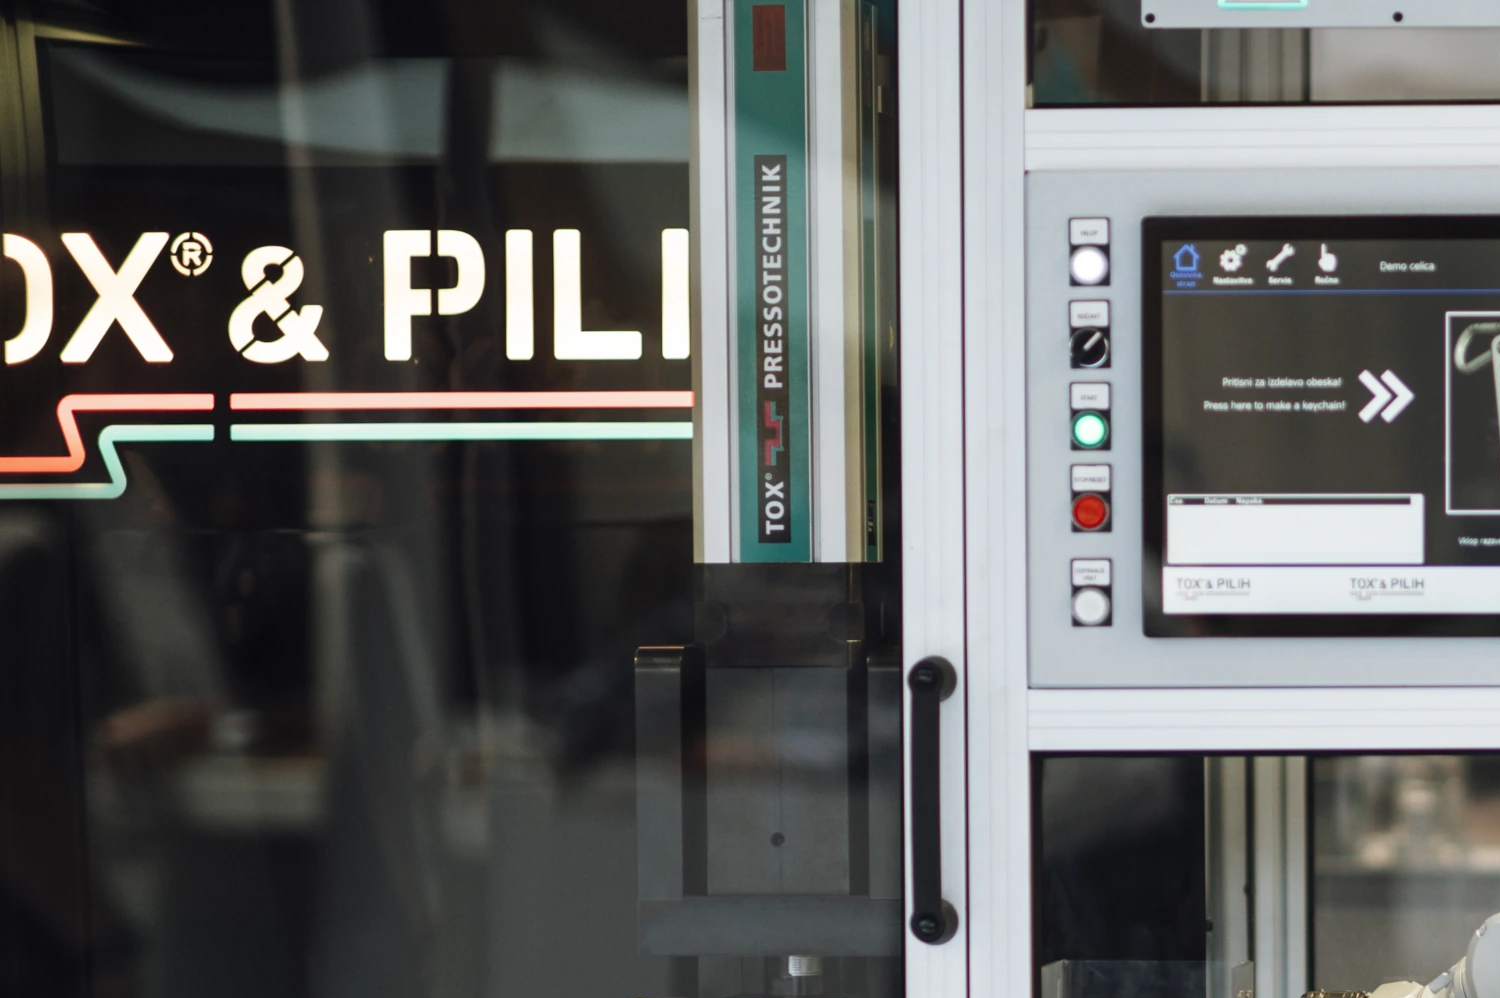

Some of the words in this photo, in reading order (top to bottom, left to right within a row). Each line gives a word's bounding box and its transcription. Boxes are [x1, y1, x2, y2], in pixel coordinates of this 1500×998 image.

[1379, 261, 1407, 272] Demo
[1408, 261, 1436, 272] celica
[761, 163, 783, 389] PRESSOTECHNIK
[1268, 276, 1292, 285] Servis
[228, 244, 330, 363] &
[383, 227, 691, 362] PILI
[1222, 377, 1252, 388] Pritisni
[1255, 380, 1265, 388] za
[1268, 377, 1303, 388] izdelavo
[1306, 377, 1342, 388] obeska!
[1203, 401, 1229, 411] Press
[1231, 401, 1251, 411] here
[1254, 402, 1264, 411] to
[1266, 401, 1291, 411] make
[1302, 401, 1346, 413] keychain!
[1217, 578, 1251, 589] PILIH
[1391, 578, 1425, 589] PILIH
